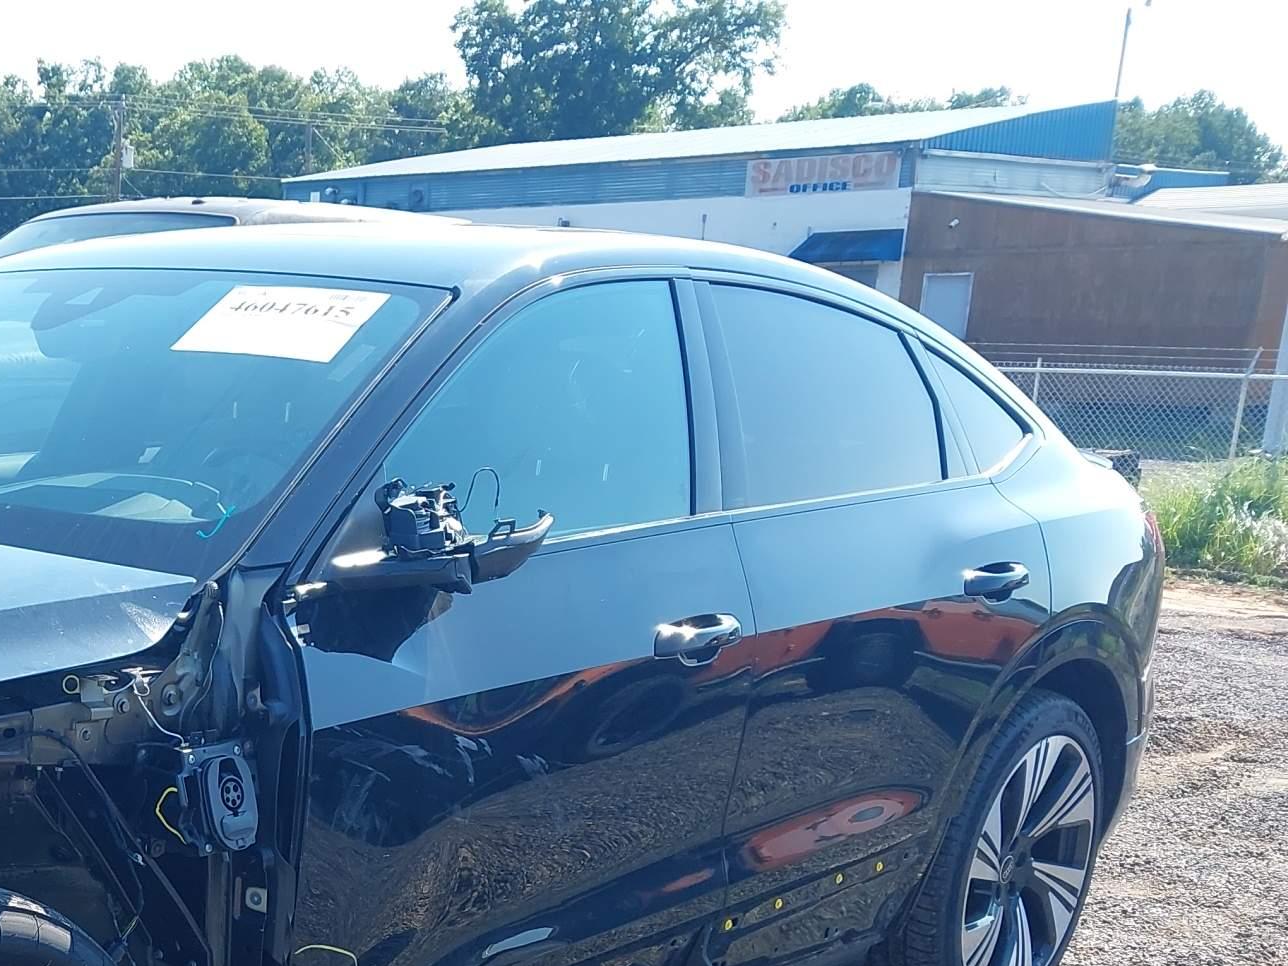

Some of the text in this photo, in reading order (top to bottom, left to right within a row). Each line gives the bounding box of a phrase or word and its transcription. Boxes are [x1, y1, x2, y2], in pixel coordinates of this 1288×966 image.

[751, 153, 896, 184] SADISCO
[789, 182, 852, 193] OFFICE
[230, 301, 354, 317] 46047615
